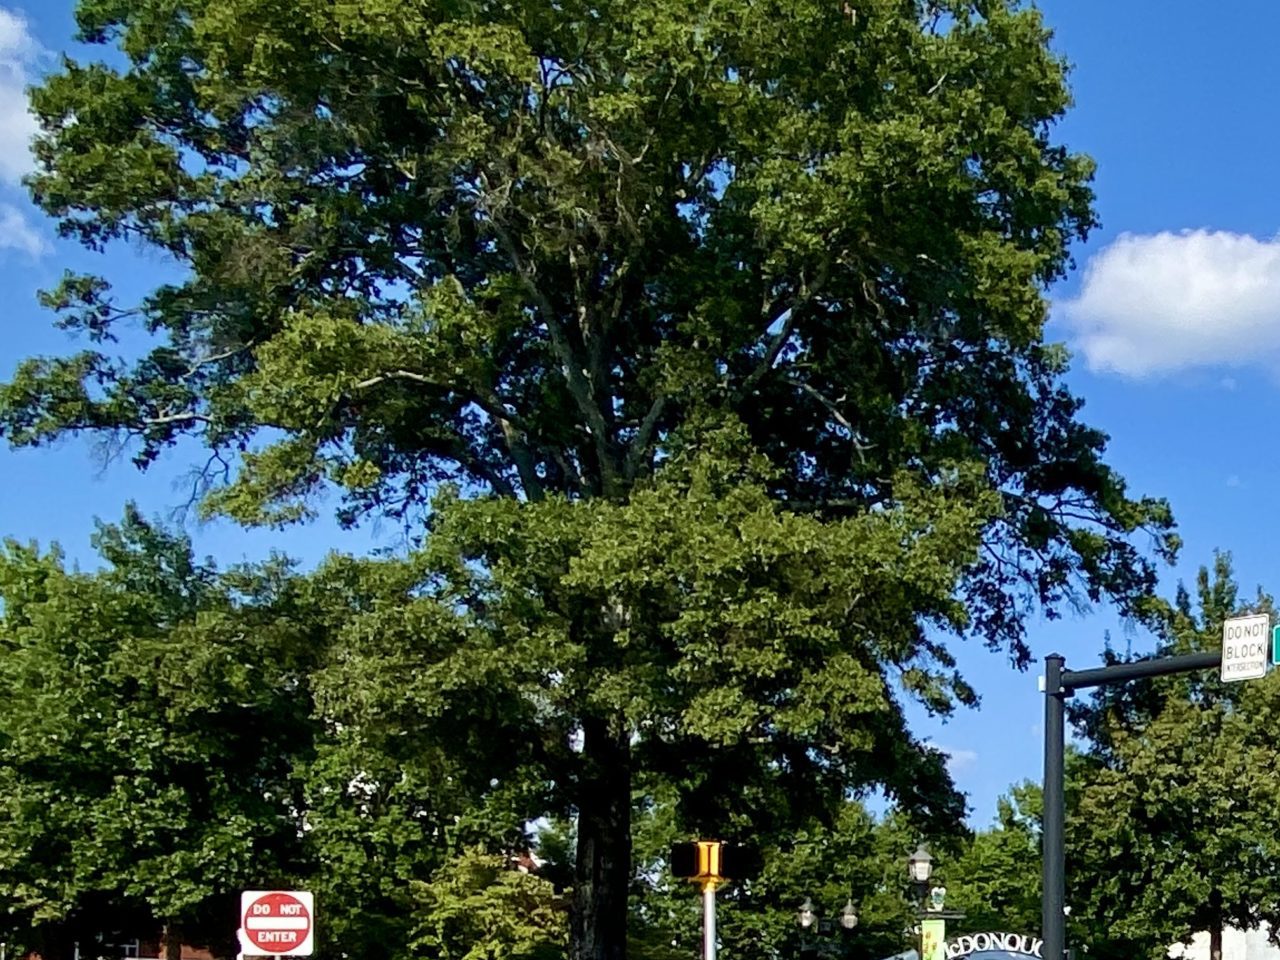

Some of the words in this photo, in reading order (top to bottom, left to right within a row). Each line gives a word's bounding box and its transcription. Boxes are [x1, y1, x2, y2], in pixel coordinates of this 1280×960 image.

[1227, 626, 1241, 641] DO
[1243, 623, 1266, 638] NOT
[1226, 642, 1265, 660] BLOCK
[253, 903, 271, 915] DO
[280, 903, 302, 915] NOT
[257, 931, 297, 943] ENTER
